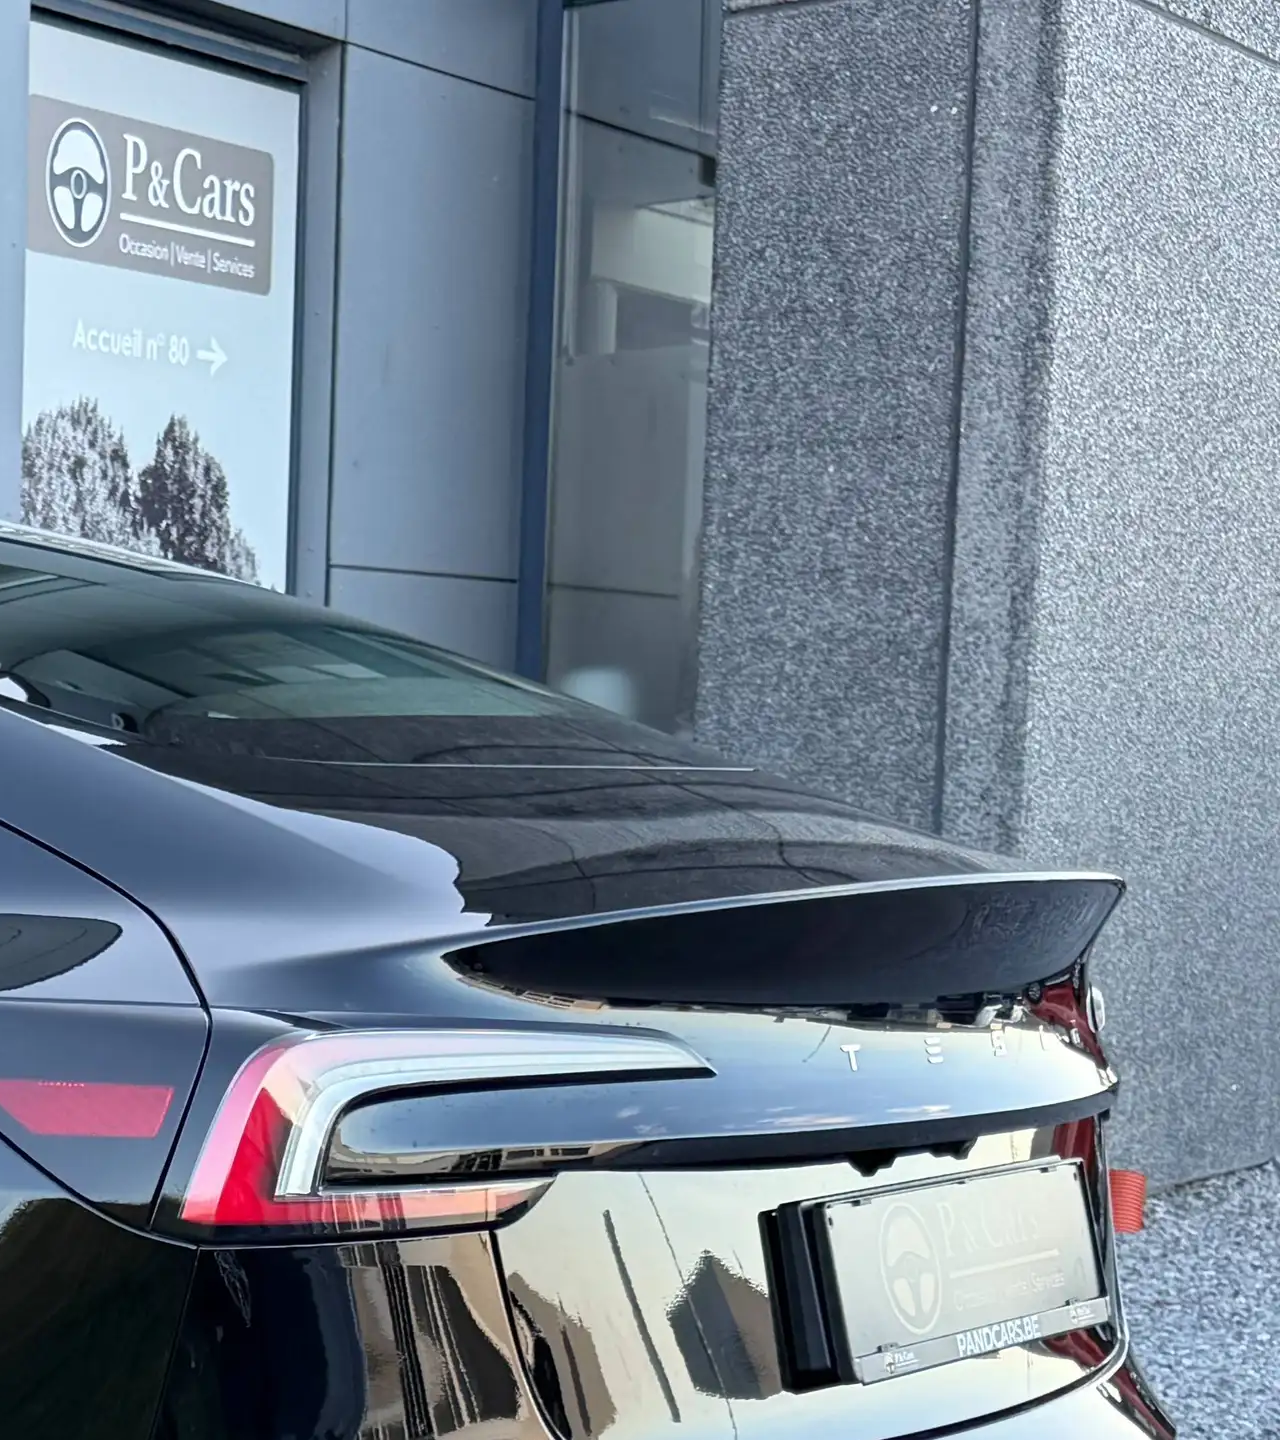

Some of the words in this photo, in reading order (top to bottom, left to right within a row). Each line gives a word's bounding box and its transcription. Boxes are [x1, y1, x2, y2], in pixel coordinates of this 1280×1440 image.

[121, 133, 255, 227] P&Cars
[119, 233, 169, 261] Occasion
[176, 245, 206, 269] Vente
[213, 252, 255, 278] Services
[72, 318, 142, 358] Accueil
[168, 334, 189, 366] 80
[956, 1315, 1042, 1357] PANDCARS.BE
